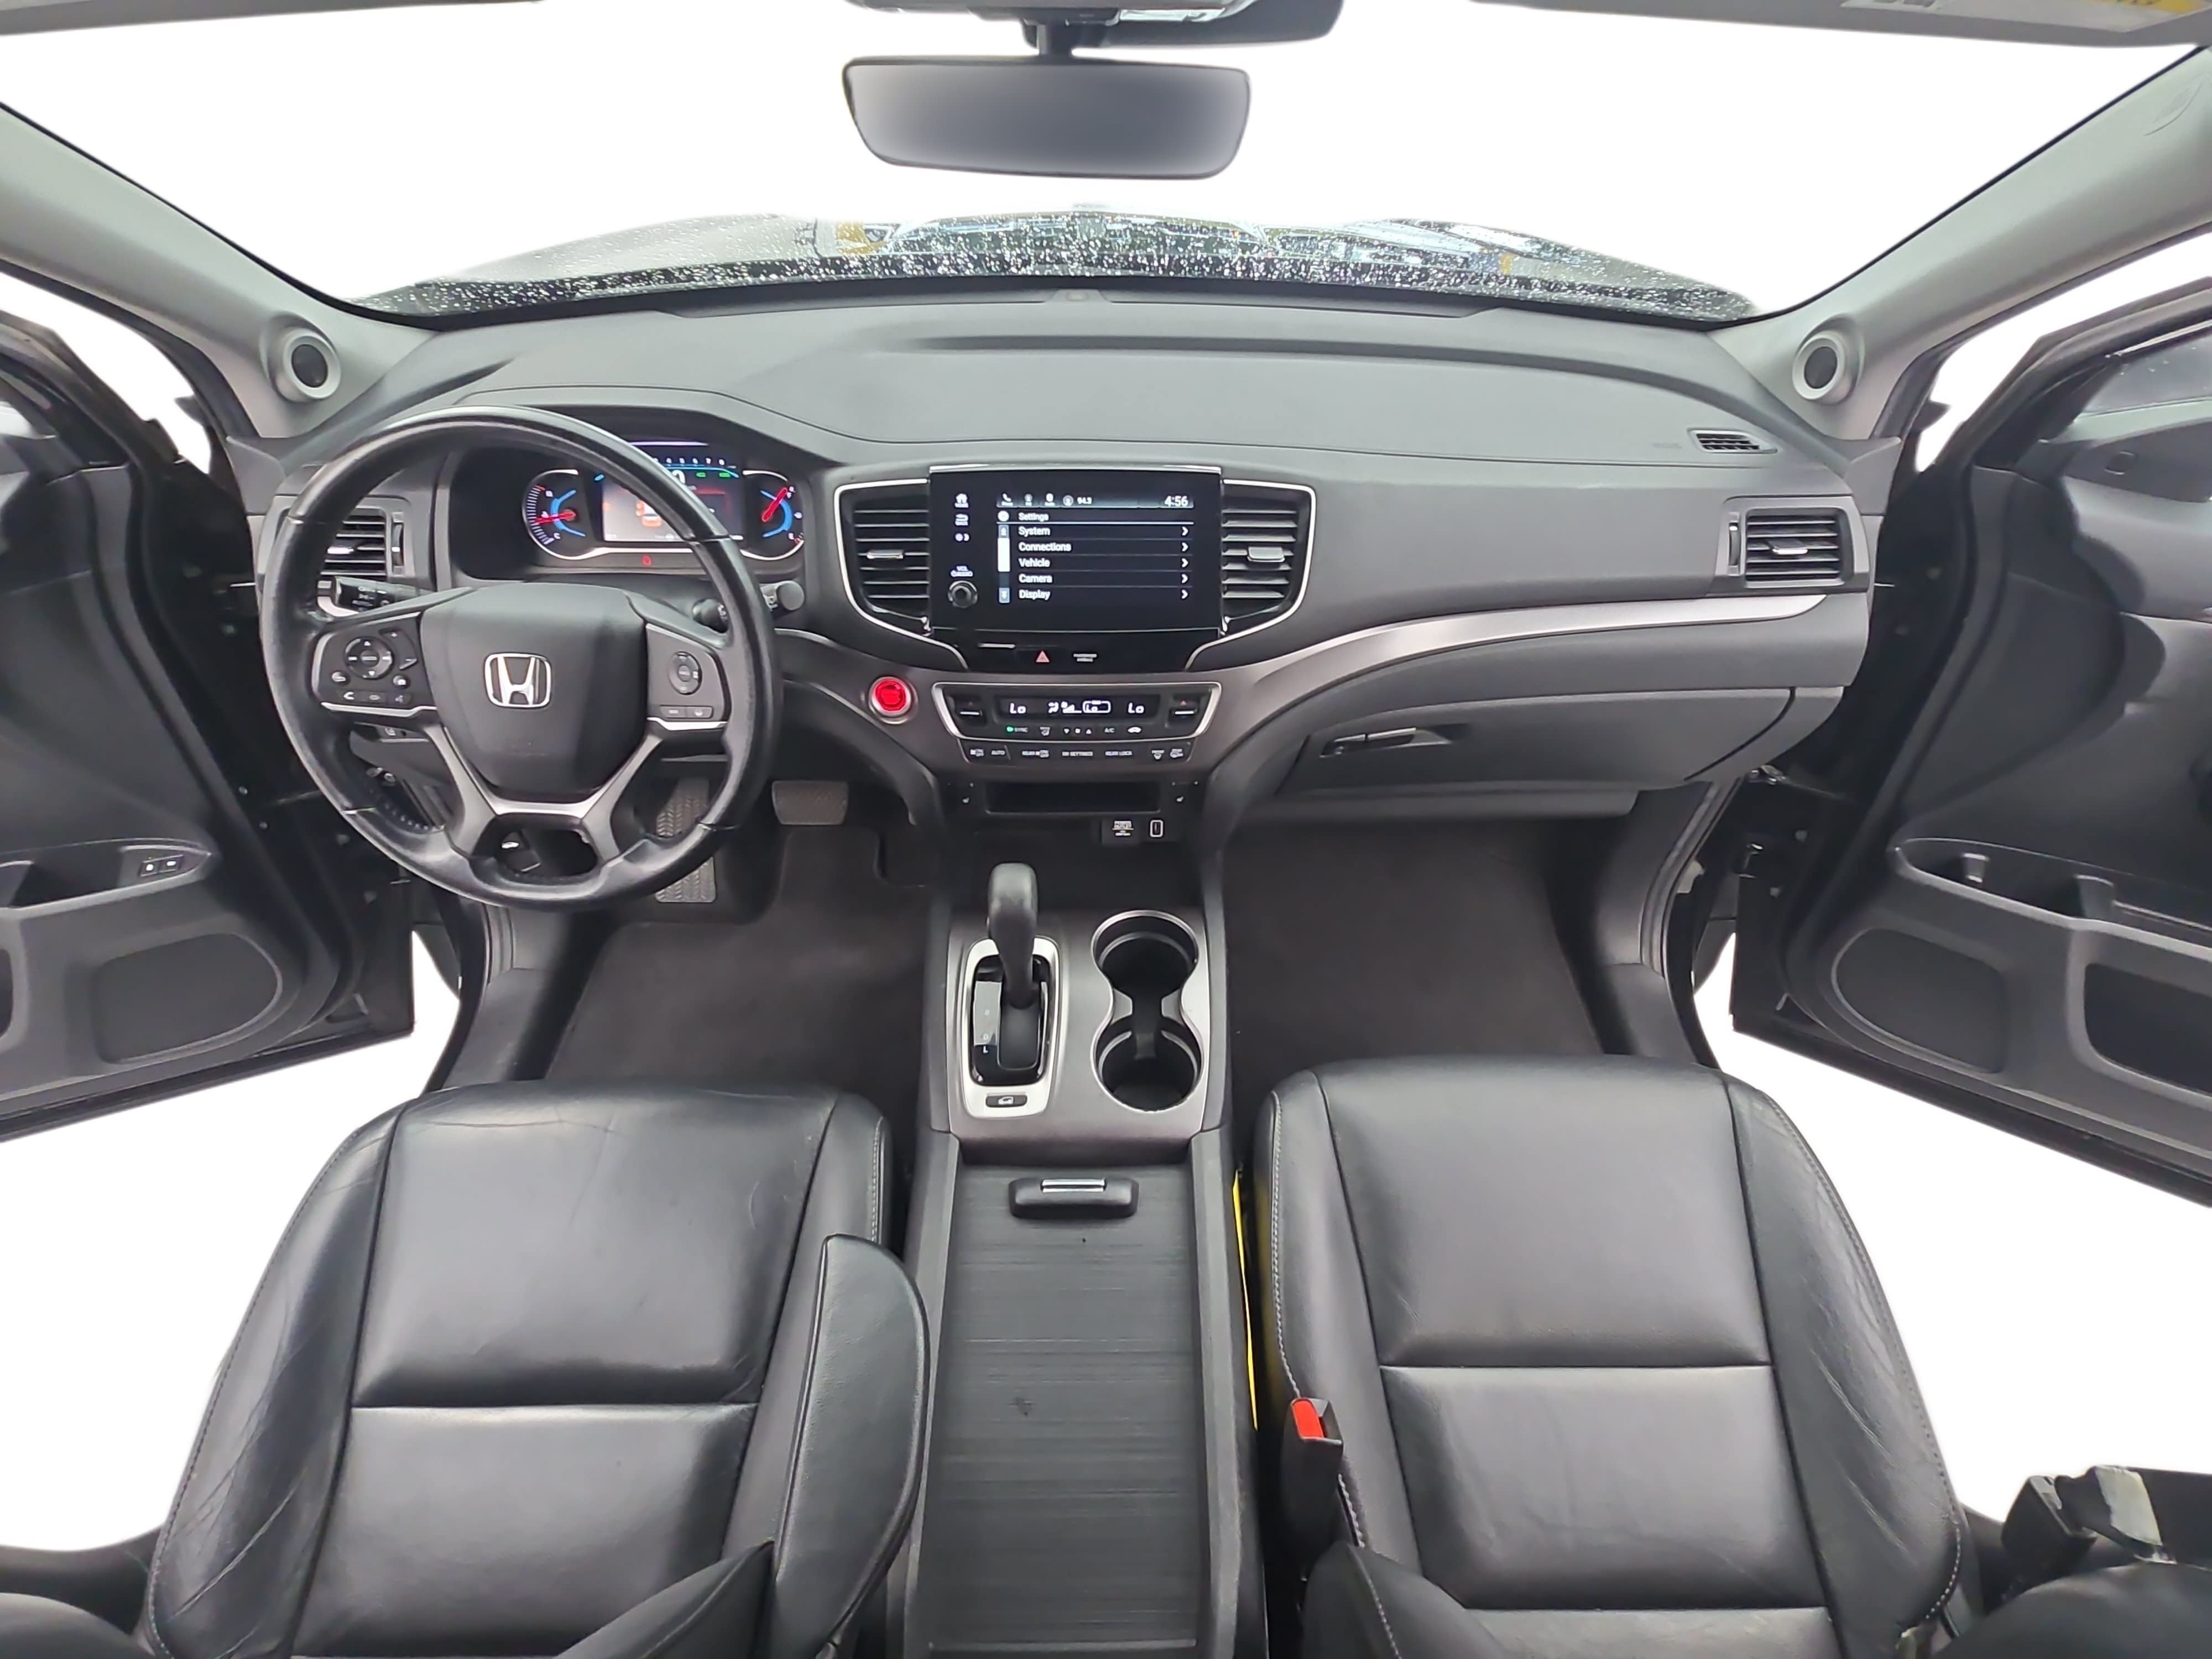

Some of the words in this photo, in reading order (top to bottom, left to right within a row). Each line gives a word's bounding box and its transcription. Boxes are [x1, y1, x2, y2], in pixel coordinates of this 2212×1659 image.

[1164, 495, 1188, 507] 4:56
[1018, 512, 1049, 522] Settings
[1018, 526, 1051, 537] System
[1018, 541, 1072, 552] Connections
[1018, 557, 1050, 567] Vehicle
[1018, 573, 1053, 583] Camera
[1019, 589, 1051, 601] Display
